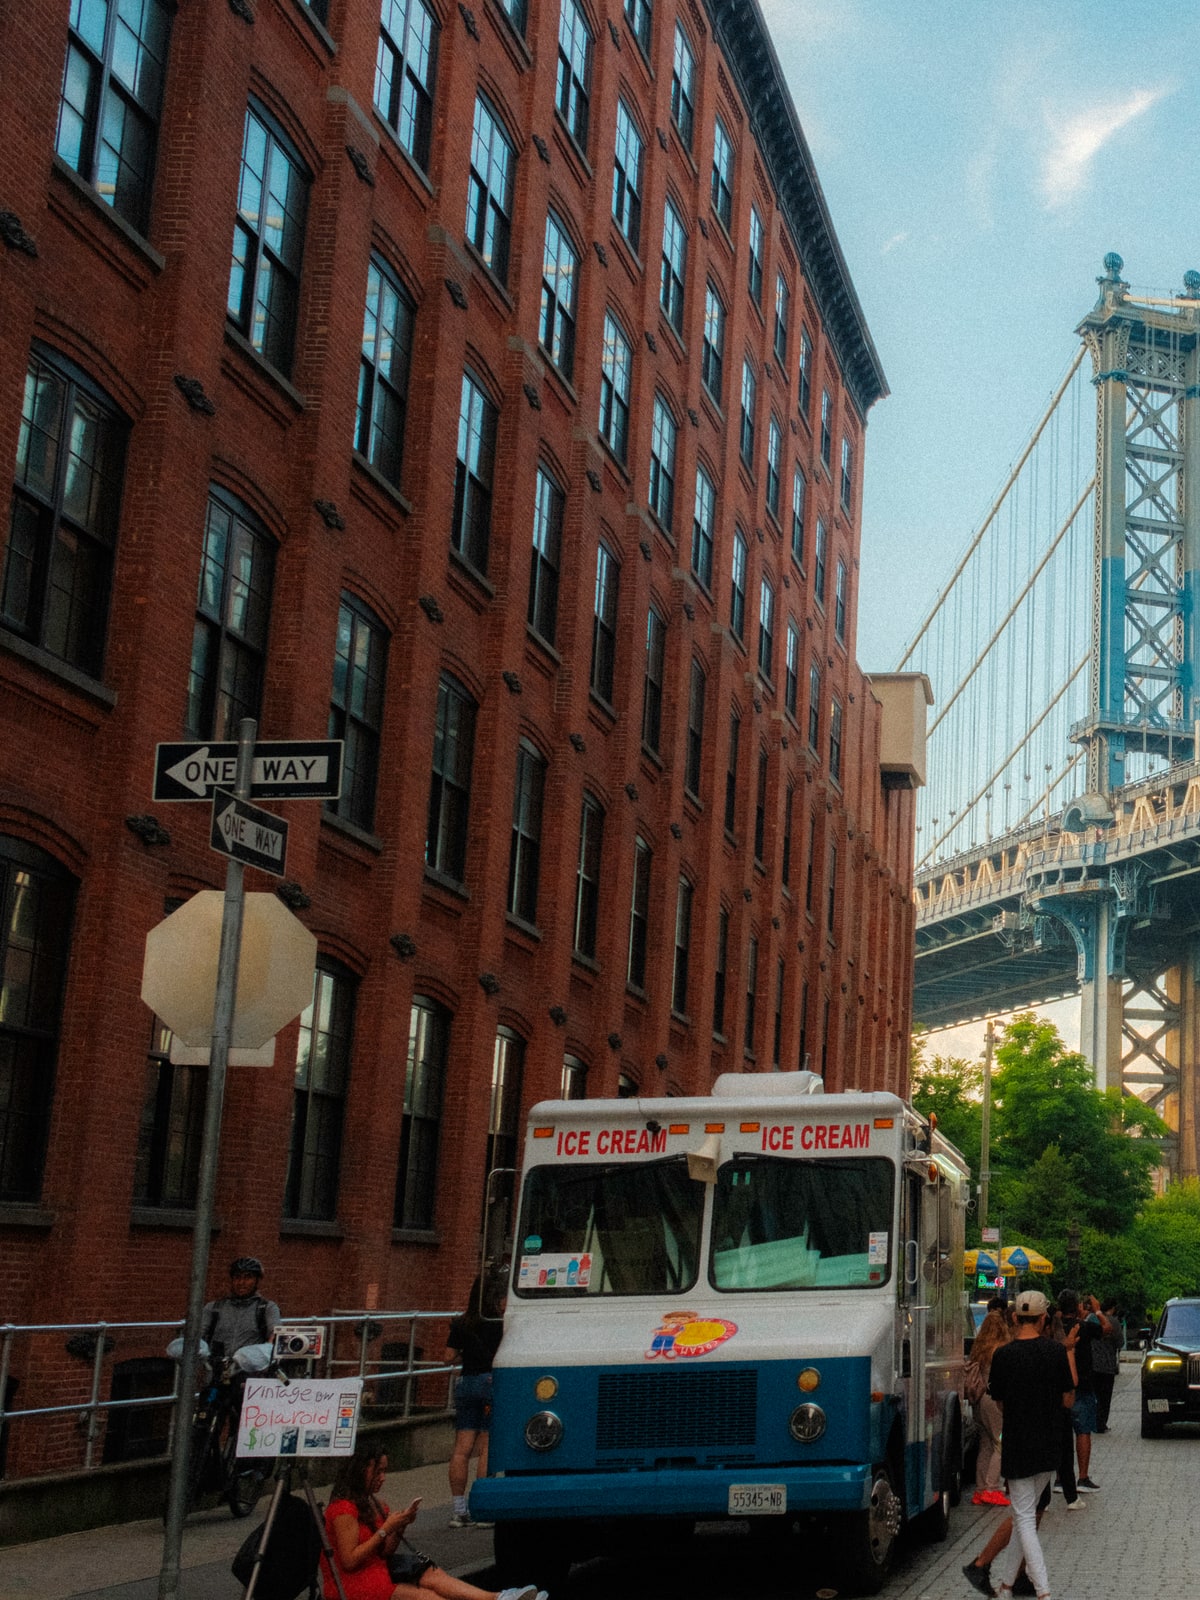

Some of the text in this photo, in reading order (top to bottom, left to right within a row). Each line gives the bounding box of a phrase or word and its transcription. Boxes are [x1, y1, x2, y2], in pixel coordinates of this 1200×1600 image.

[185, 759, 317, 782] ONE WAY
[224, 813, 278, 855] ONE WAY
[556, 1128, 668, 1156] ICE CREAM
[762, 1124, 870, 1151] ICE CREAM
[245, 1405, 330, 1428] Polaroid
[243, 1427, 276, 1450] $10
